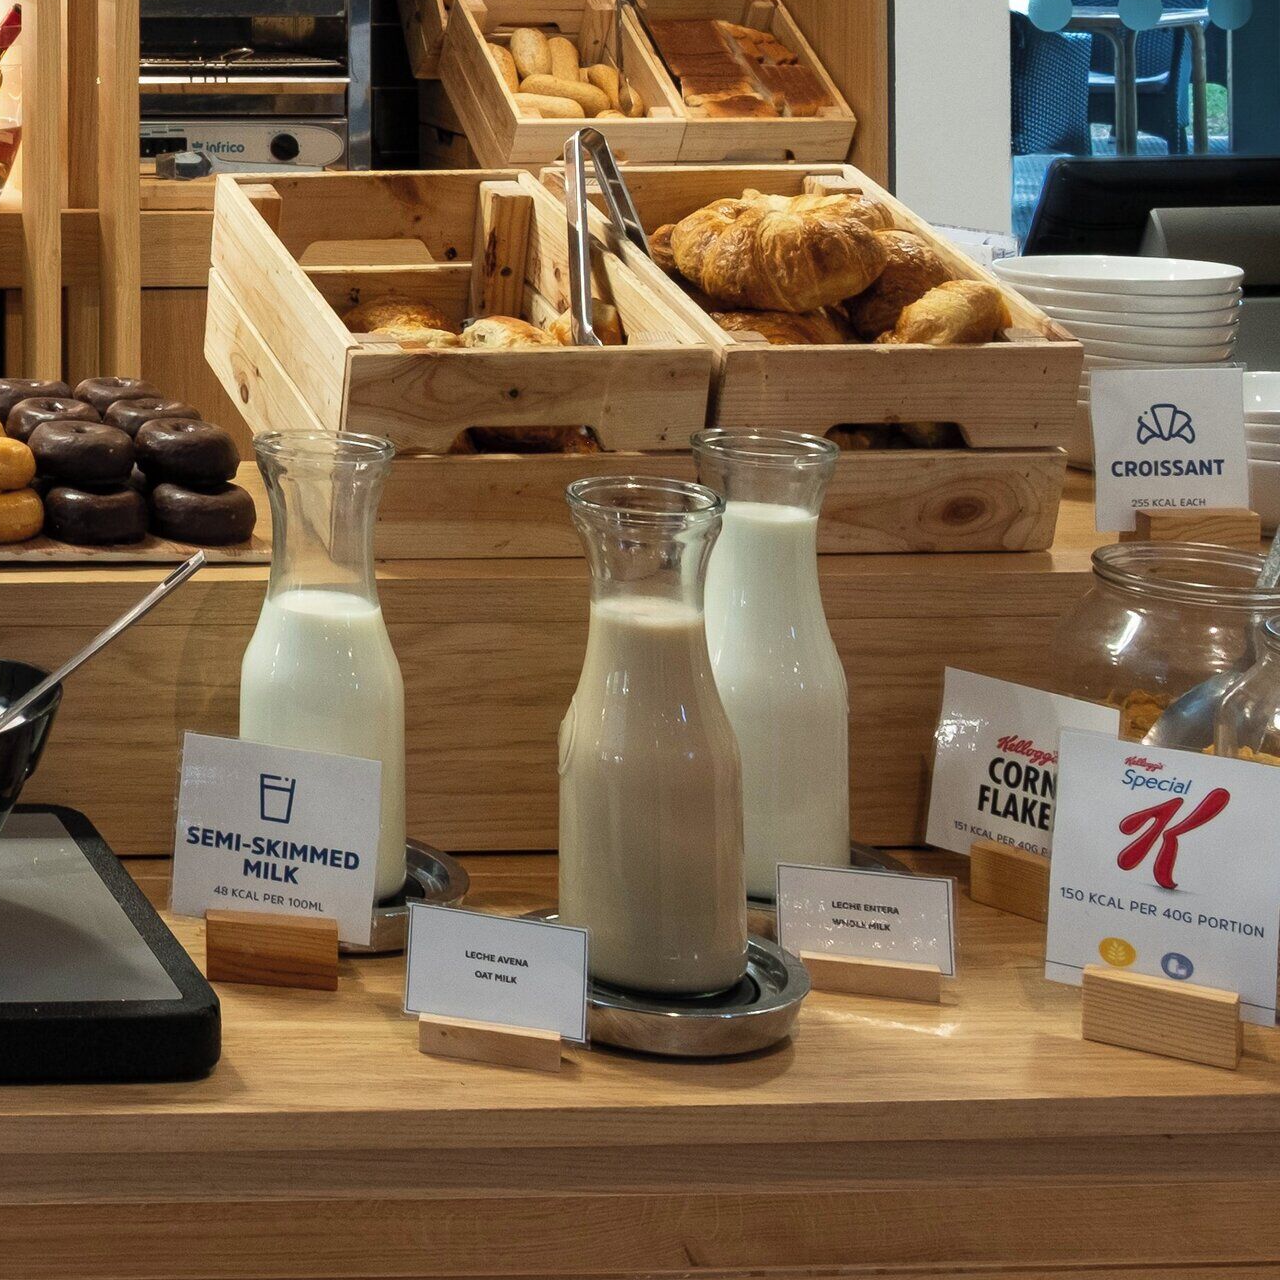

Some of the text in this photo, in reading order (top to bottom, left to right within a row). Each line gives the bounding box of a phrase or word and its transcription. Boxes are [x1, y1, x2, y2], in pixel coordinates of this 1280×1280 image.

[206, 141, 245, 153] infrico
[1111, 459, 1224, 477] CROISSANT
[1132, 498, 1206, 507] 255 KCAL EACH
[1124, 756, 1163, 772] Kellogg's
[988, 757, 1057, 799] CORN
[1122, 769, 1192, 795] Special
[978, 784, 1051, 831] FLAKE
[186, 826, 360, 870] SEMI-SKIMMED
[954, 820, 968, 831] 151
[970, 826, 993, 840] KCAL
[997, 834, 1015, 848] PER
[1018, 841, 1038, 853] 40G
[1117, 787, 1231, 889] K
[243, 858, 299, 884] MILK
[214, 885, 324, 912] 48 KCAL PER 100ML
[831, 901, 899, 915] LECHE ENTERA
[1060, 886, 1265, 938] 150 KCAL PER 40G PORTION
[868, 922, 891, 931] MILK
[465, 950, 528, 967] LECHE AVENA
[475, 970, 517, 984] OAT MILK
